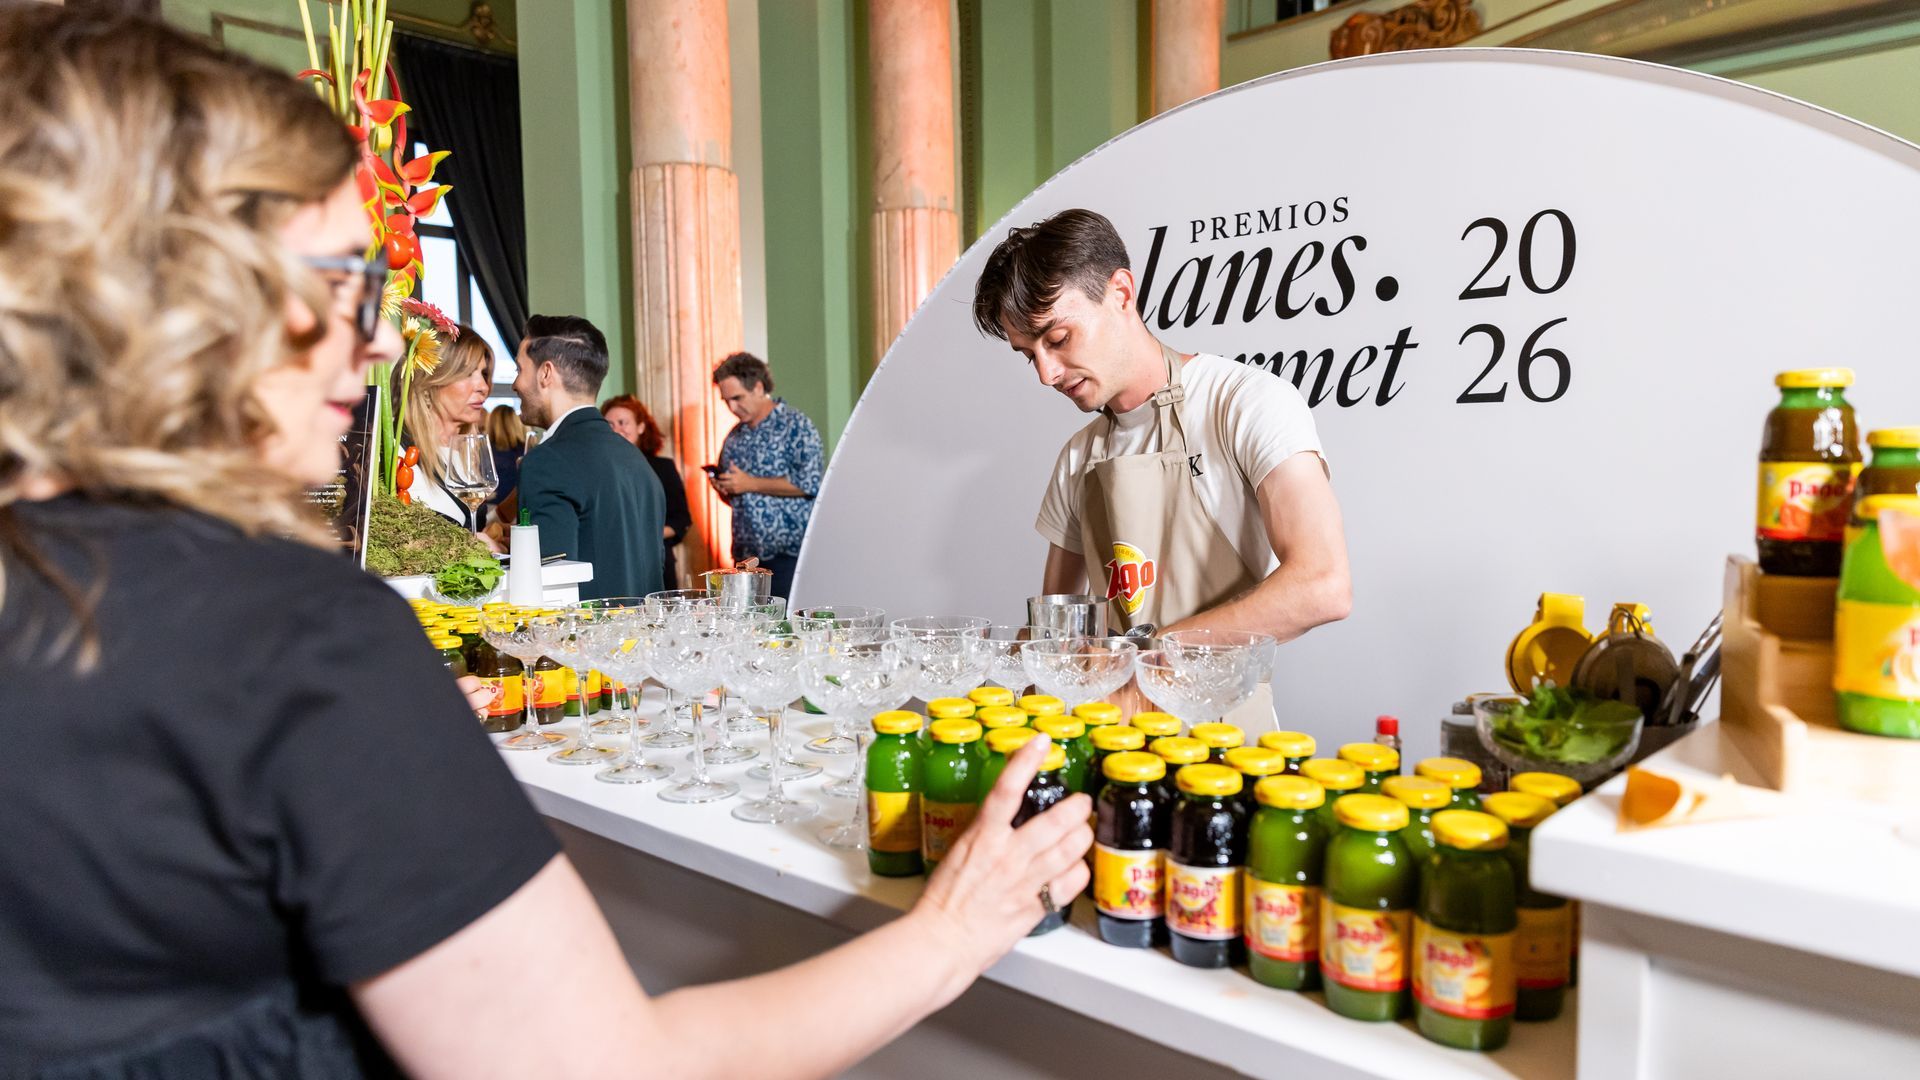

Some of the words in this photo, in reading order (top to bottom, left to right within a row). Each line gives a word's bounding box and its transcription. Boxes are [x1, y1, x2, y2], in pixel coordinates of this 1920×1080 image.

[1190, 196, 1349, 243] PREMIOS
[1458, 208, 1576, 300] 20
[1456, 317, 1571, 404] 26
[1188, 453, 1204, 478] K
